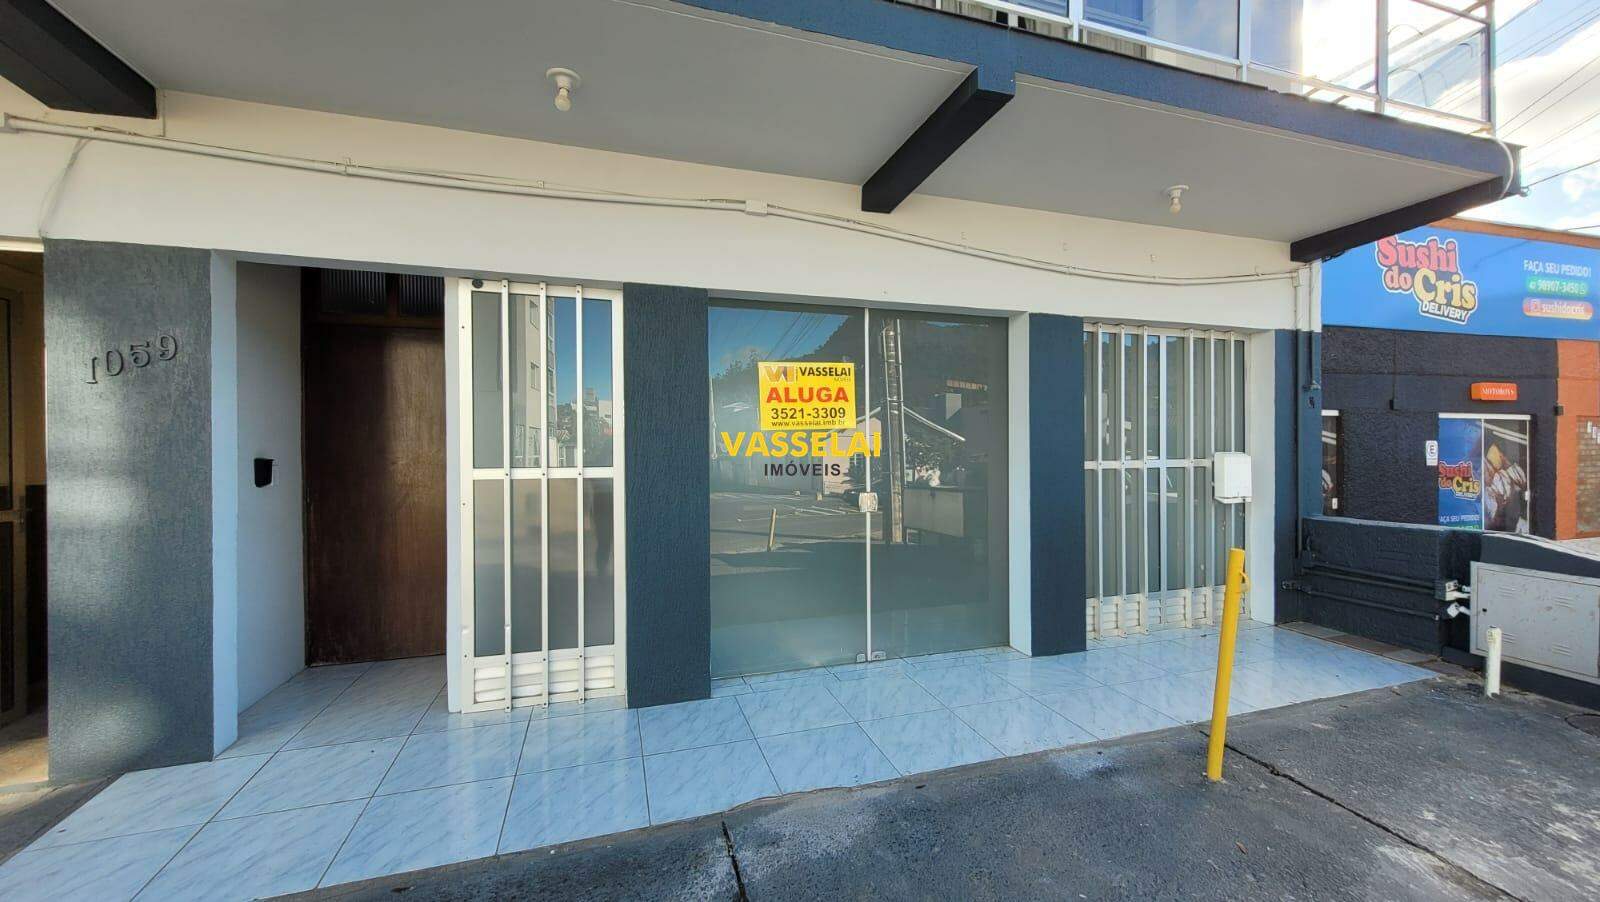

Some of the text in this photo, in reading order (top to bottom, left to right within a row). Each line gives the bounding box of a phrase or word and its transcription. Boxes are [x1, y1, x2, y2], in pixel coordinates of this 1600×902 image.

[1376, 235, 1458, 272] Sushi
[1523, 260, 1543, 274] FAÇA
[1545, 262, 1559, 274] SEU
[1385, 268, 1477, 311] do Cris
[1423, 301, 1467, 322] DELIVERY
[85, 334, 178, 385] 1059
[799, 367, 851, 377] VASSELAI
[766, 387, 849, 403] ALUGA
[771, 408, 846, 419] 3521-3309
[1453, 477, 1480, 493] Cris
